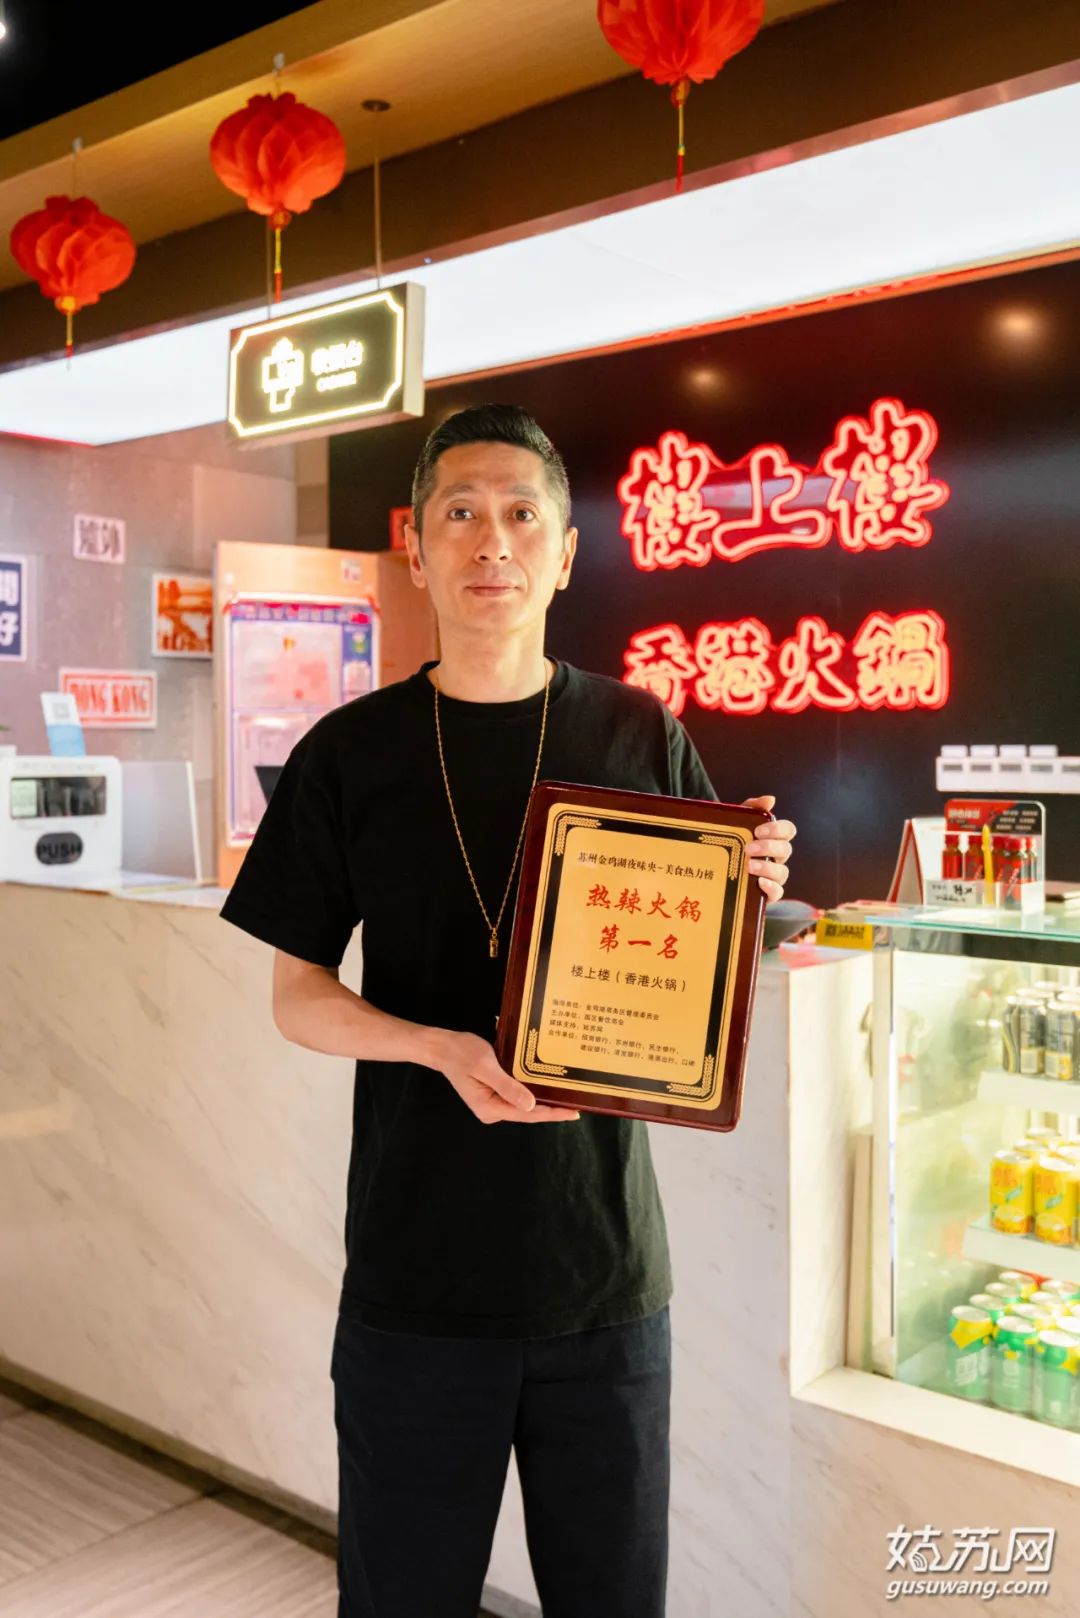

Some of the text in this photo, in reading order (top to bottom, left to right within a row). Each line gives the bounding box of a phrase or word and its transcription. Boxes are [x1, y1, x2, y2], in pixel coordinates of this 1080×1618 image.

[587, 884, 701, 922] 热辣火锅
[600, 924, 678, 960] 第一名
